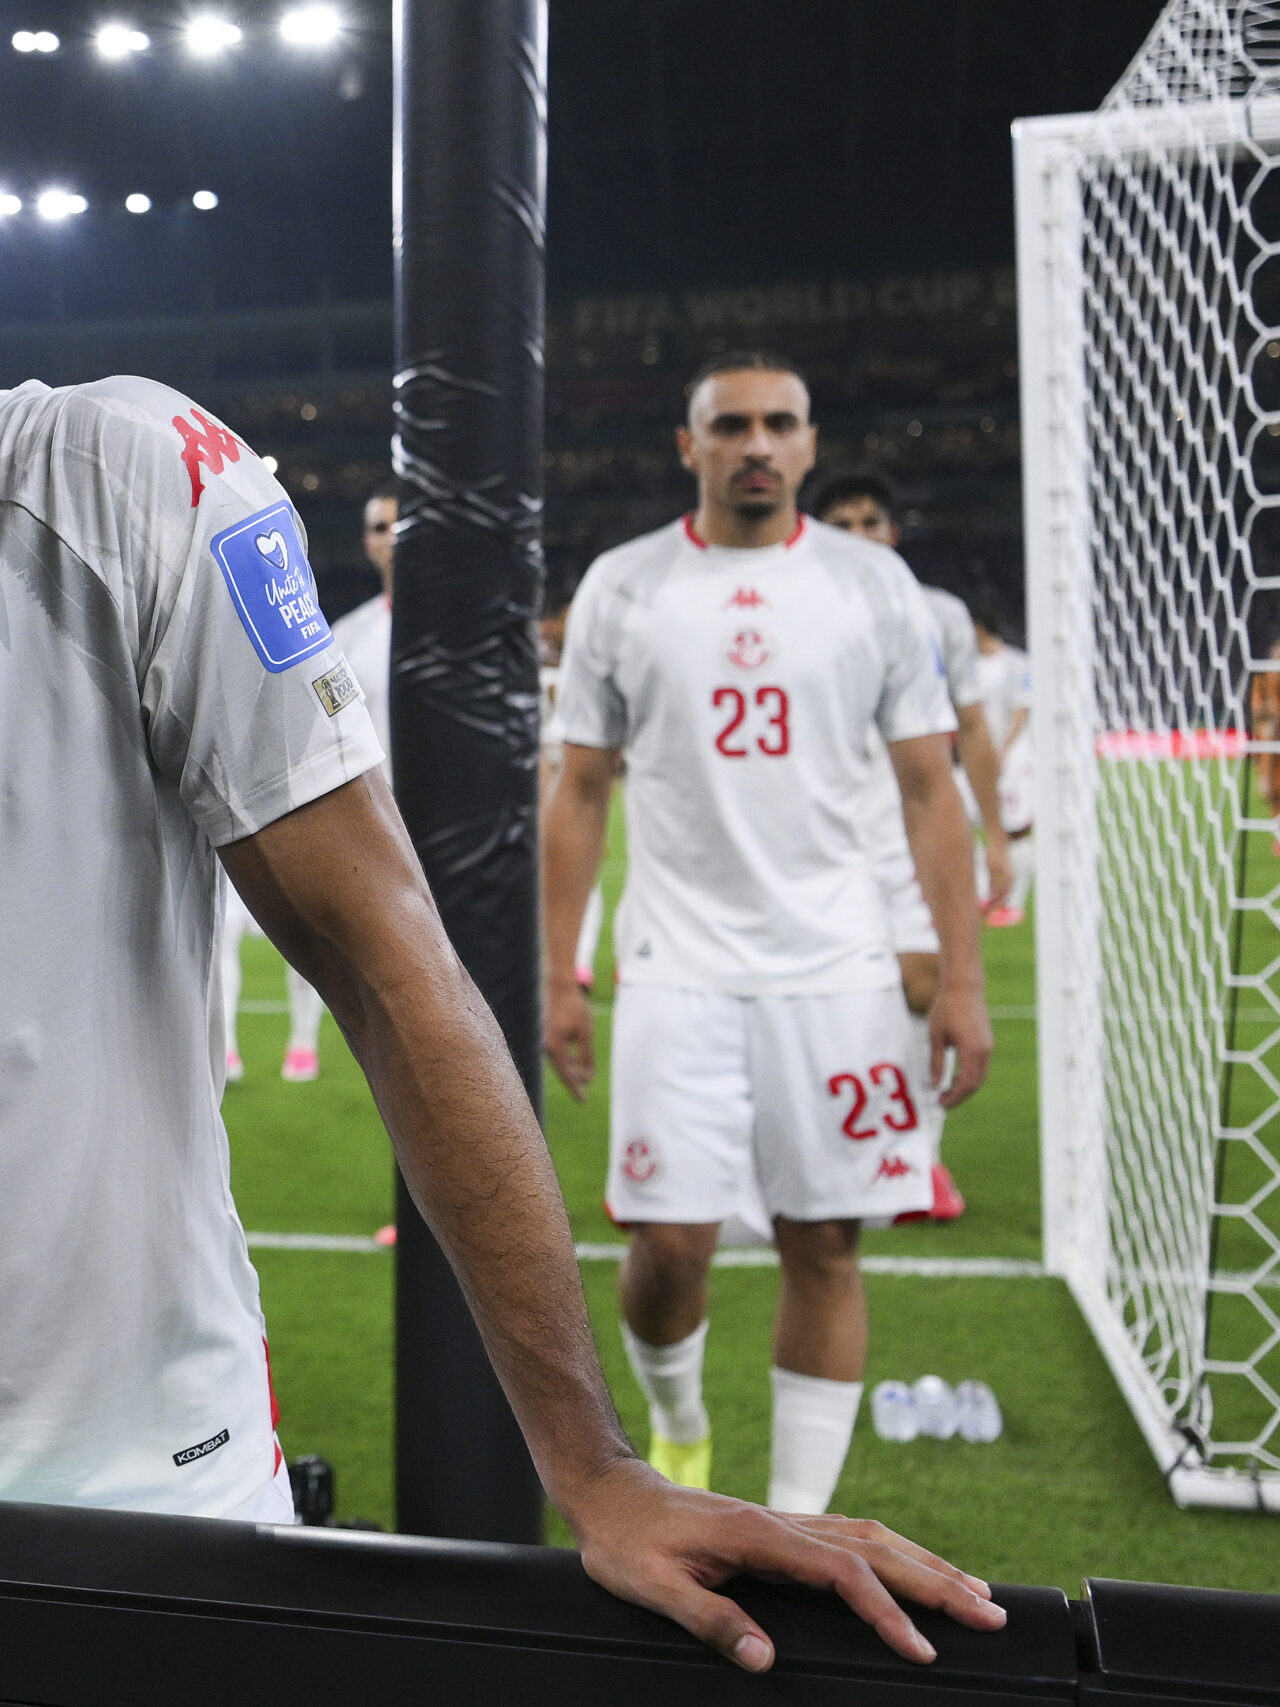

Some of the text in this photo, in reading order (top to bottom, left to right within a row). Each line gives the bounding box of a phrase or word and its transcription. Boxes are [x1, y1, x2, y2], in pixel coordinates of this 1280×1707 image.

[686, 283, 867, 326] WORLD
[880, 275, 977, 316] CUP
[265, 574, 299, 606] Unite
[301, 621, 321, 639] FIFA
[713, 687, 789, 757] 23
[829, 1063, 918, 1139] 23
[177, 1432, 226, 1463] KOMBAT
